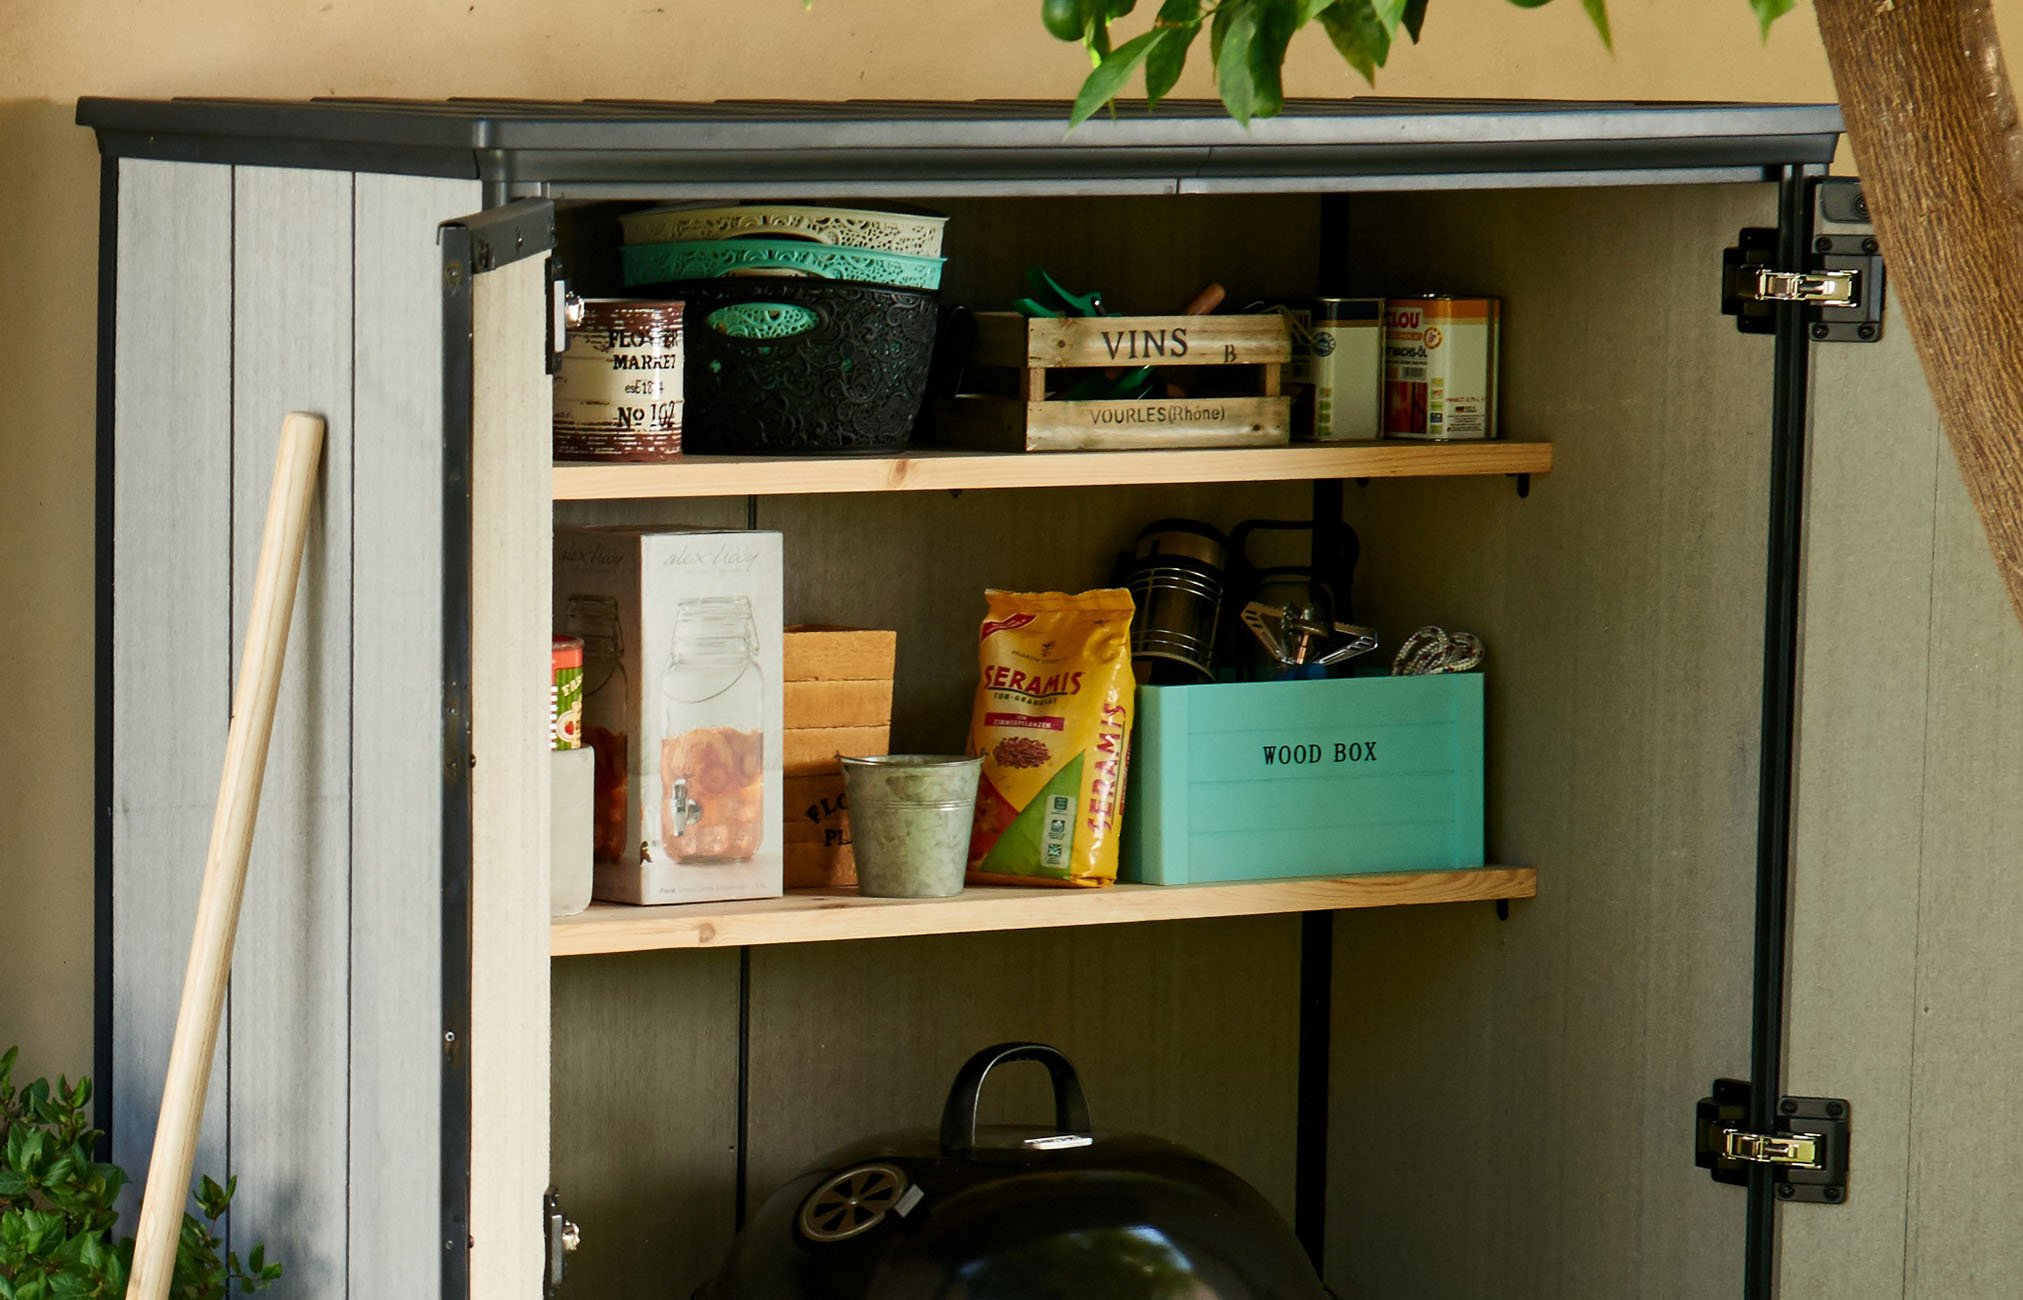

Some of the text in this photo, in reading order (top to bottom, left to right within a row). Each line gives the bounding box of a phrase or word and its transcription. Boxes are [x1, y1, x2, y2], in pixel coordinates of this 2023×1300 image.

[1101, 327, 1188, 360] VINS
[1224, 344, 1237, 363] B
[613, 354, 676, 370] MARKET
[984, 664, 1082, 696] SERAMIS
[1263, 741, 1377, 765] WOOD BOX
[1087, 703, 1126, 833] SERAMIS
